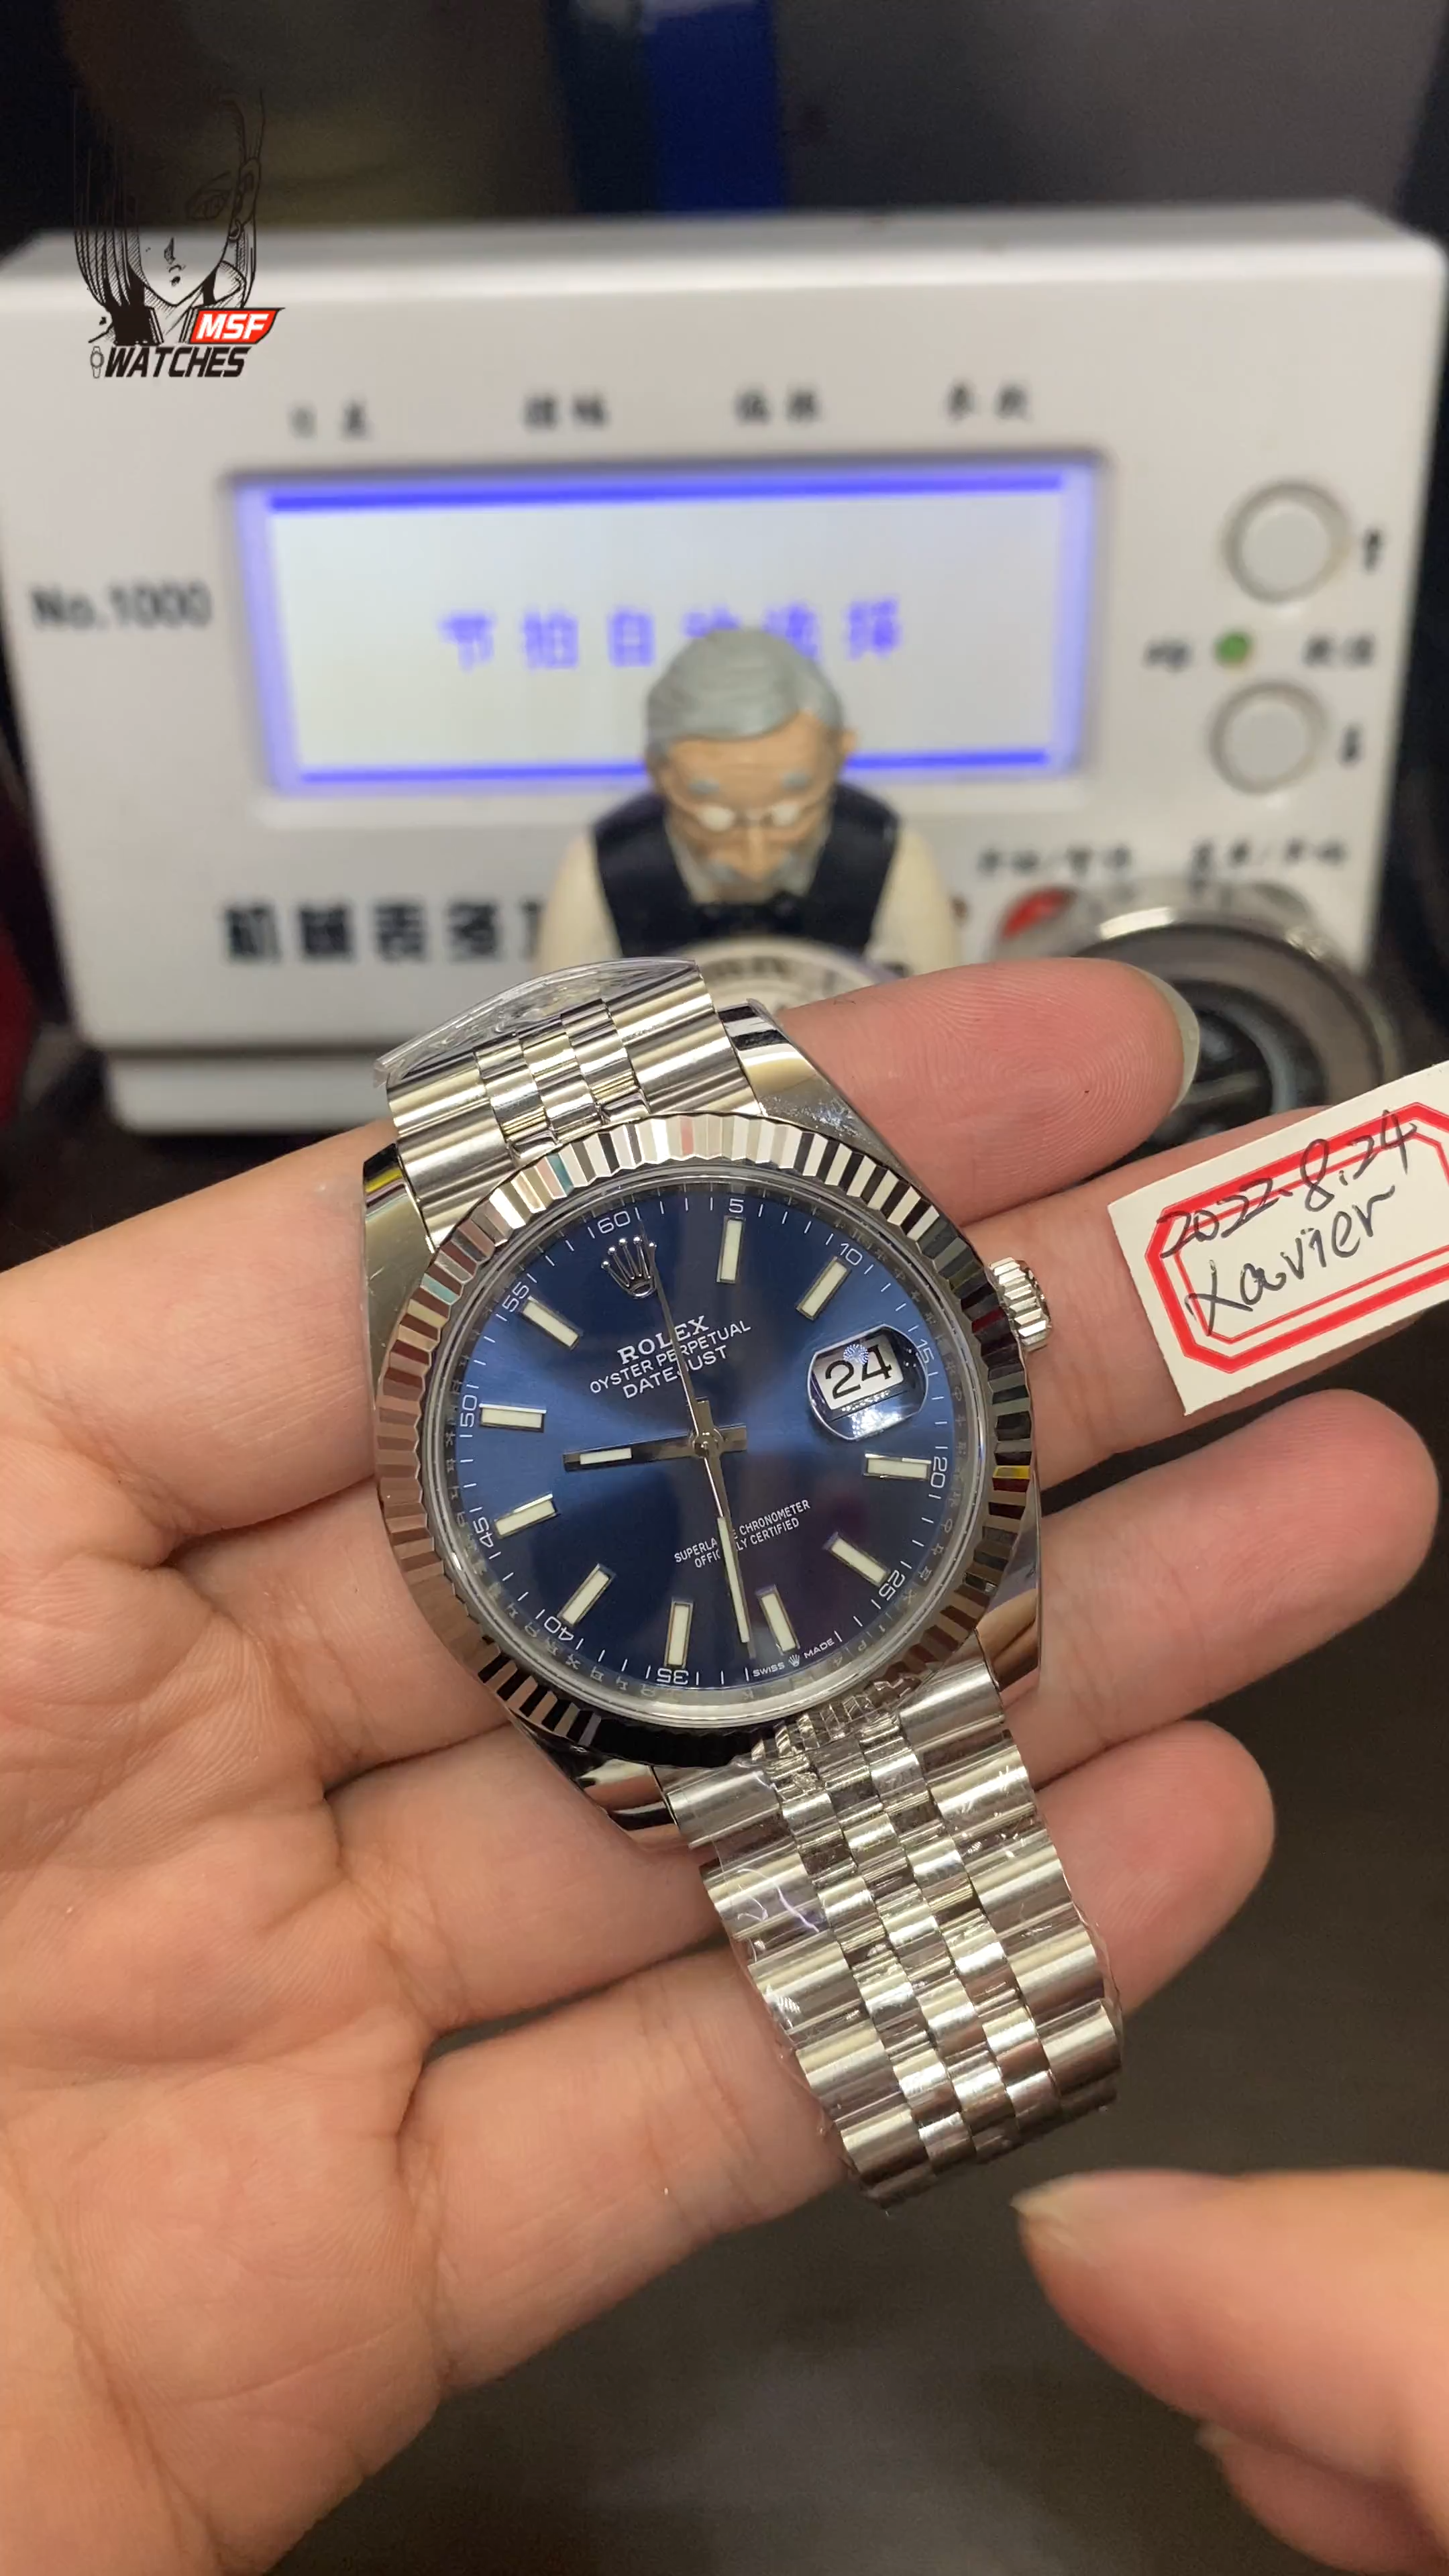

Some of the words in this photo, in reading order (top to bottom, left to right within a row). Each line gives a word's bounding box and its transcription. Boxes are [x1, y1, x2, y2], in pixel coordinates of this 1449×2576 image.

[729, 1198, 744, 1214] 5
[597, 1210, 633, 1235] 60
[839, 1242, 863, 1265] 10
[501, 1284, 530, 1313] 55
[616, 1315, 710, 1364] ROLEX
[918, 1338, 934, 1365] 15
[590, 1359, 654, 1394] OYSTER
[655, 1320, 752, 1367] PERPETUAL
[824, 1344, 893, 1400] 24
[460, 1394, 478, 1428] 50
[930, 1456, 948, 1489] 20
[472, 1515, 494, 1548] 45
[674, 1529, 738, 1564] SUPERLA
[739, 1499, 811, 1536] CHRONOMETER
[749, 1517, 800, 1545] CERTIFIED
[878, 1569, 906, 1601] 25
[543, 1615, 574, 1642] 40
[753, 1662, 786, 1677] SWISS
[804, 1638, 835, 1659] MADE
[656, 1668, 689, 1686] 35
